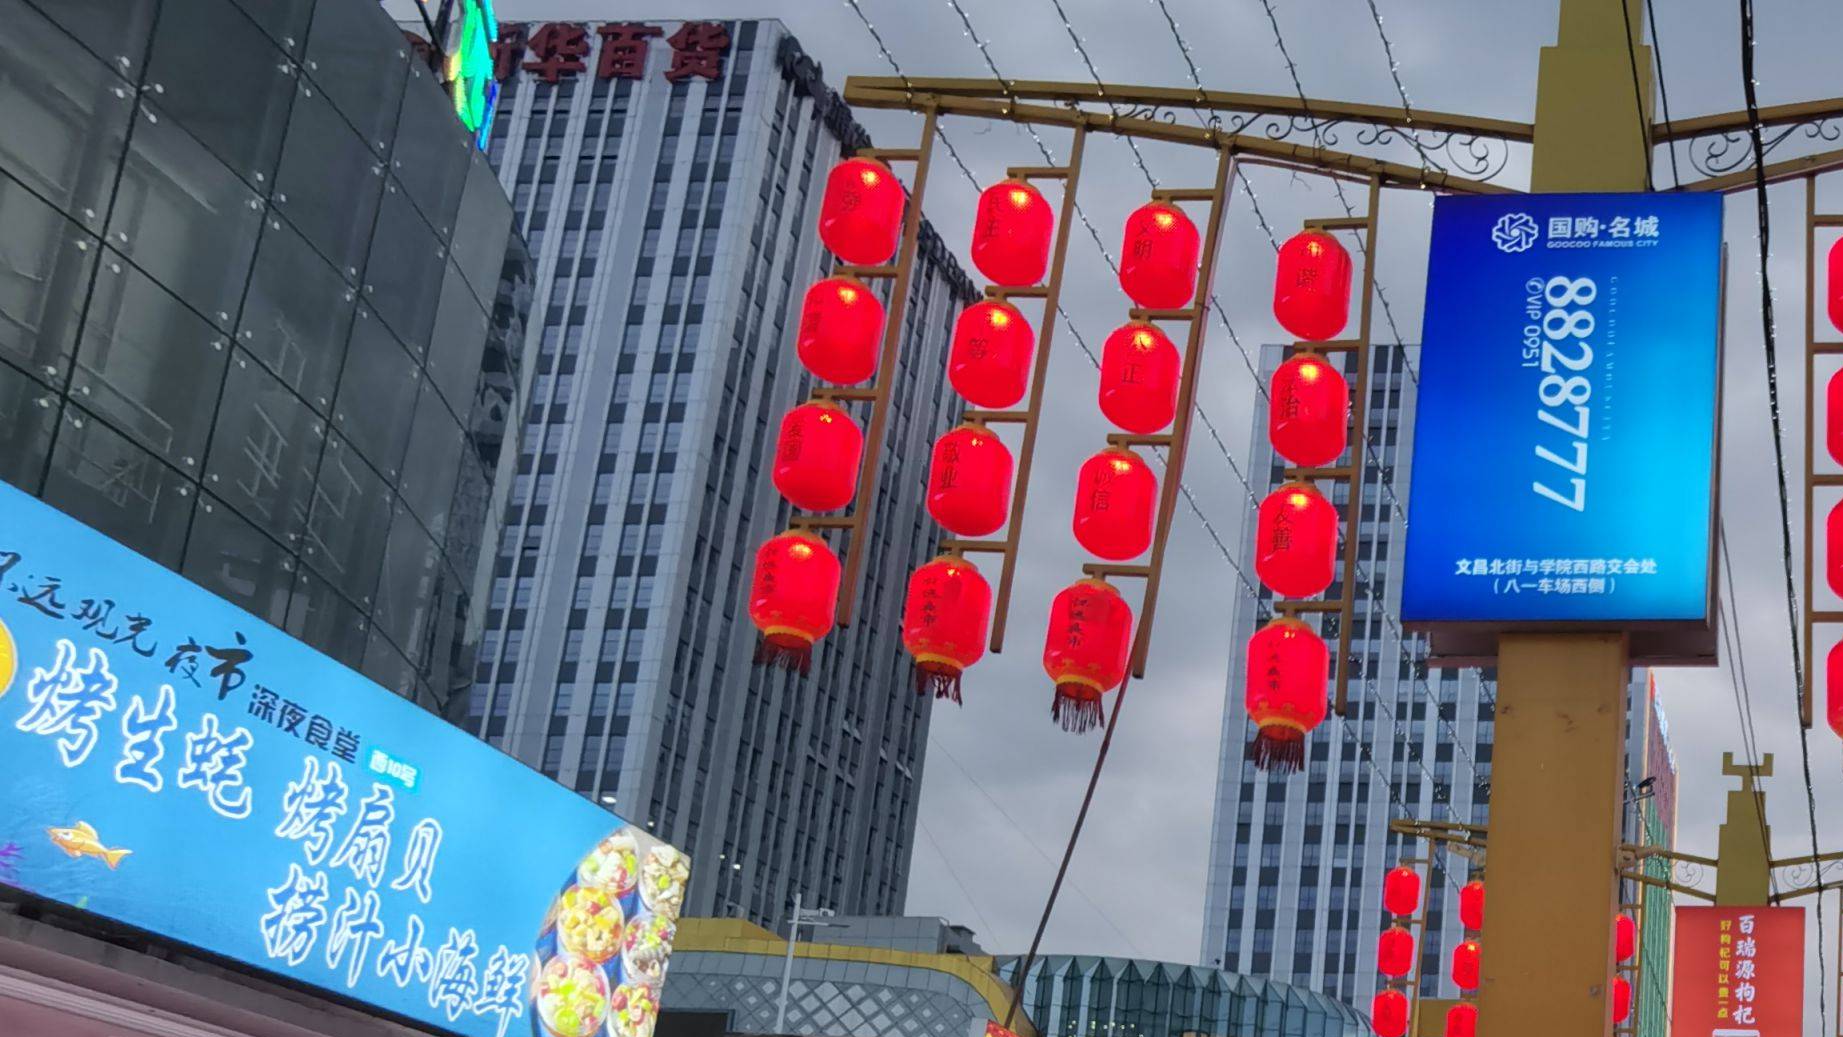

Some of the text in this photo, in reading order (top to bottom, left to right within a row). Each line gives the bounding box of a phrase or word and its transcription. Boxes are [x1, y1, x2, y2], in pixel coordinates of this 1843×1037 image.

[1547, 215, 1660, 239] 国购·名城
[1635, 239, 1660, 248] CITY
[1522, 293, 1542, 368] VIP 0951
[1532, 275, 1597, 512] 8828777
[1455, 558, 1657, 576] 文昌北街与学院西路交会处
[17, 639, 252, 818] 烤生蚝
[247, 683, 361, 764] 深夜食堂
[275, 756, 443, 903] 烤扇贝
[1733, 914, 1757, 1026] 百瑞源枸杞
